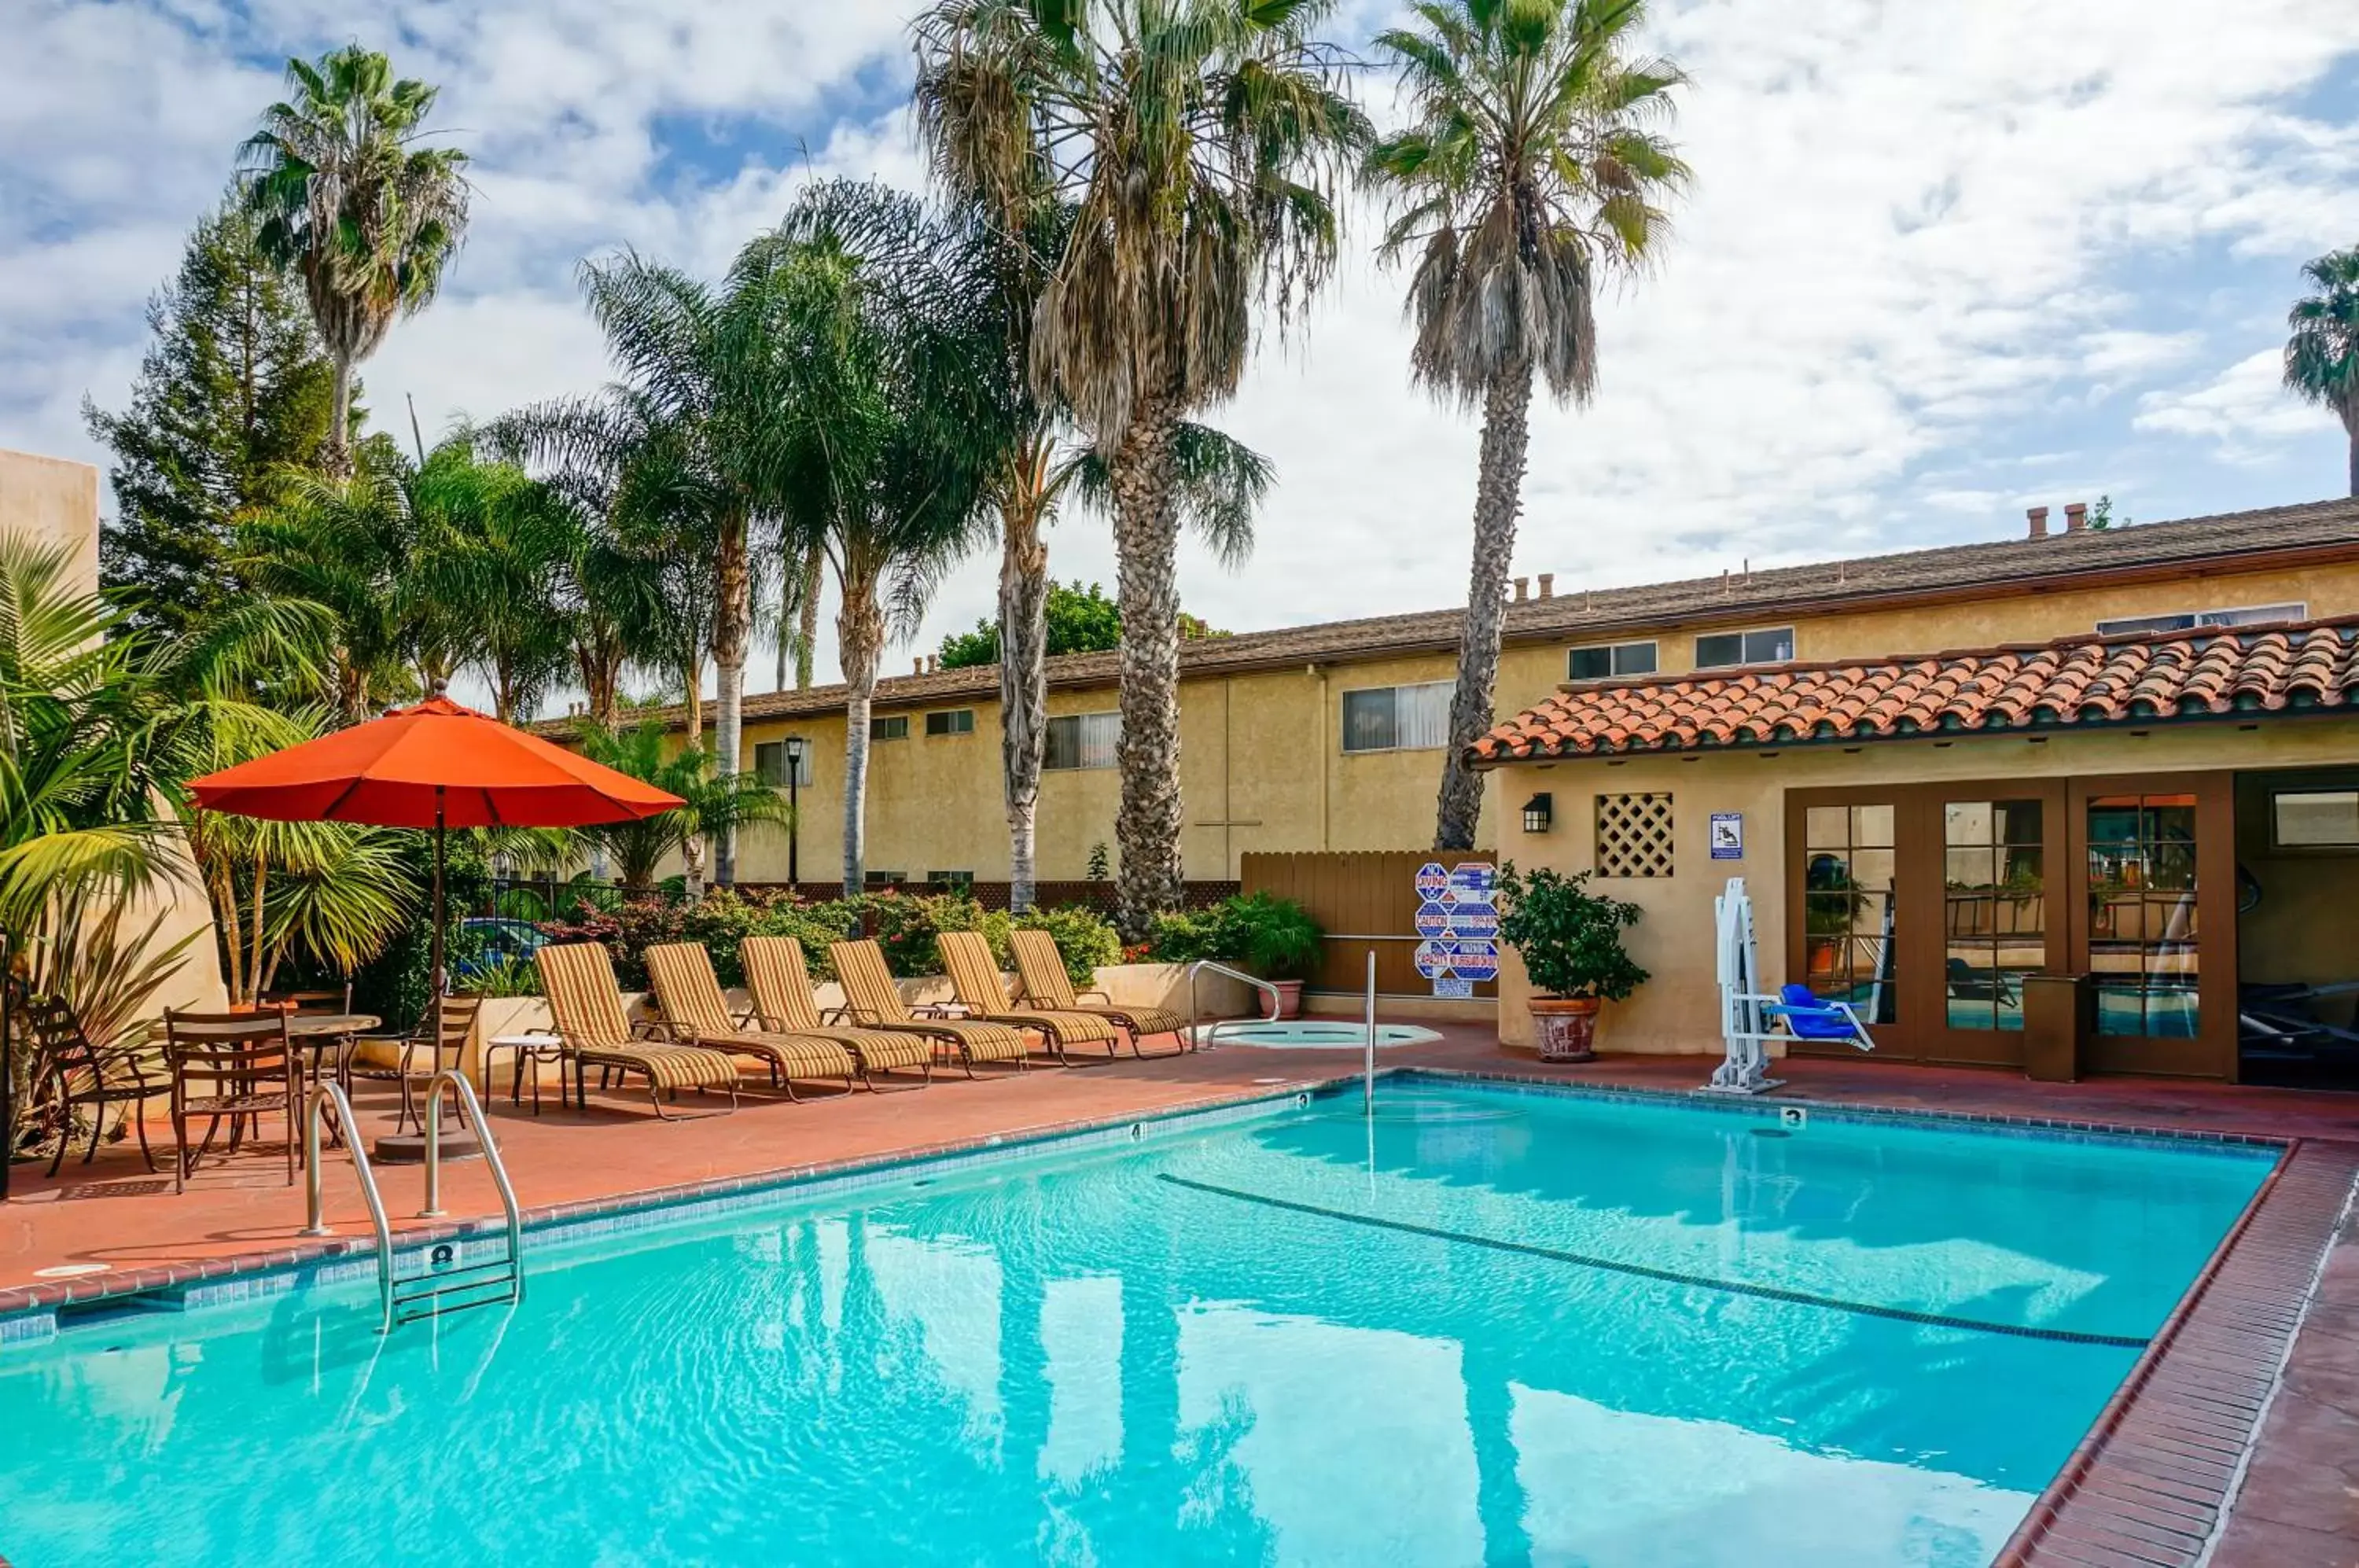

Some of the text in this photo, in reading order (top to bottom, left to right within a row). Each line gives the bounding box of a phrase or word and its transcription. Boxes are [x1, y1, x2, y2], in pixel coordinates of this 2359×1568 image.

[1427, 865, 1439, 876] NO
[1417, 876, 1448, 886] DIVING
[1417, 916, 1448, 926] CAUTION
